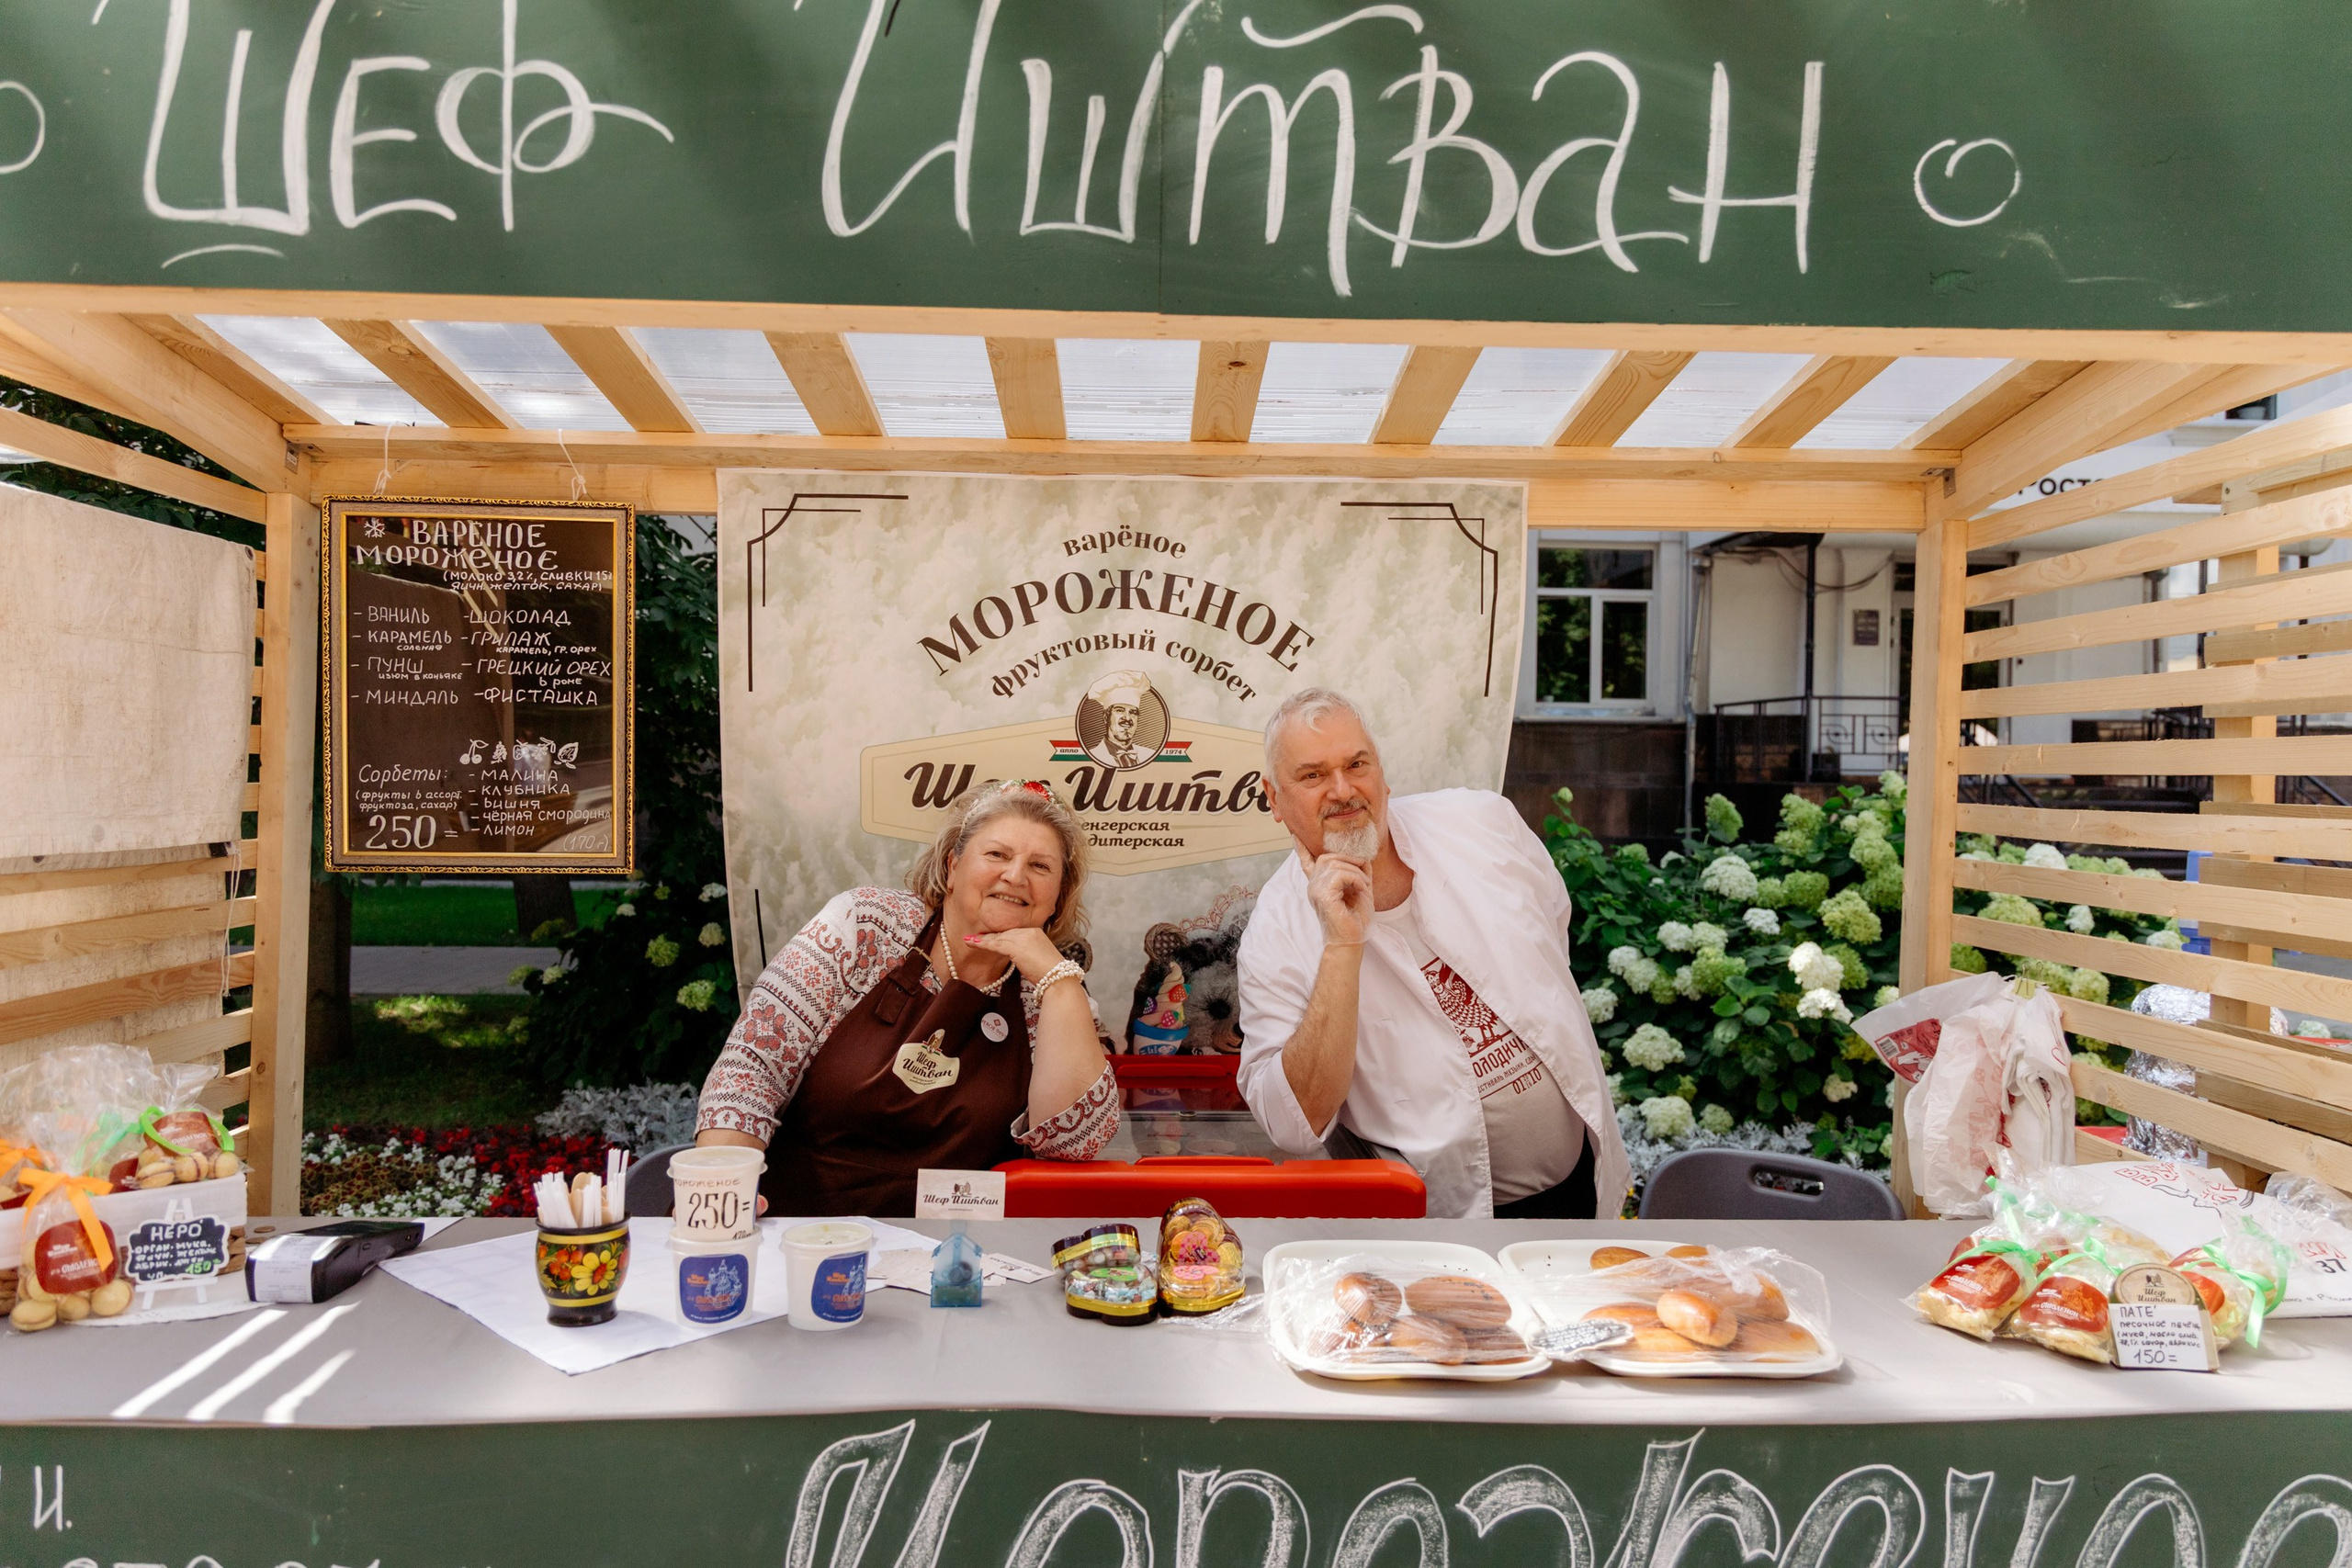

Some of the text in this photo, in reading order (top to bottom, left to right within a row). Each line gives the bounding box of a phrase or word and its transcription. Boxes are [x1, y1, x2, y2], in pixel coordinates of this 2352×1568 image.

[2019, 479, 2103, 495] ОСТ
[1062, 525, 1187, 558] варёное
[368, 606, 430, 625] ВАНИЛЬ
[917, 569, 1315, 676] МОРОЖЕНОЕ
[368, 630, 452, 644] КАРАМЕЛЬ
[368, 656, 611, 676] ПУНШ ГРЕЦКИЙ ОРЕХ
[990, 628, 1257, 703] фруктовый сорбет
[366, 689, 458, 706] МИНДАЛЬ
[481, 769, 559, 782] МАЛИНА
[481, 784, 570, 796] КЛУБНИКА
[1064, 766, 1271, 813] Иштв
[483, 824, 535, 836] ЛИМОН
[1081, 821, 1170, 834] енгерская
[1088, 834, 1184, 850] дитерская
[902, 1058, 954, 1078] Иштван
[916, 1051, 937, 1070] Шеф
[923, 1194, 1000, 1206] Шеф Иштван
